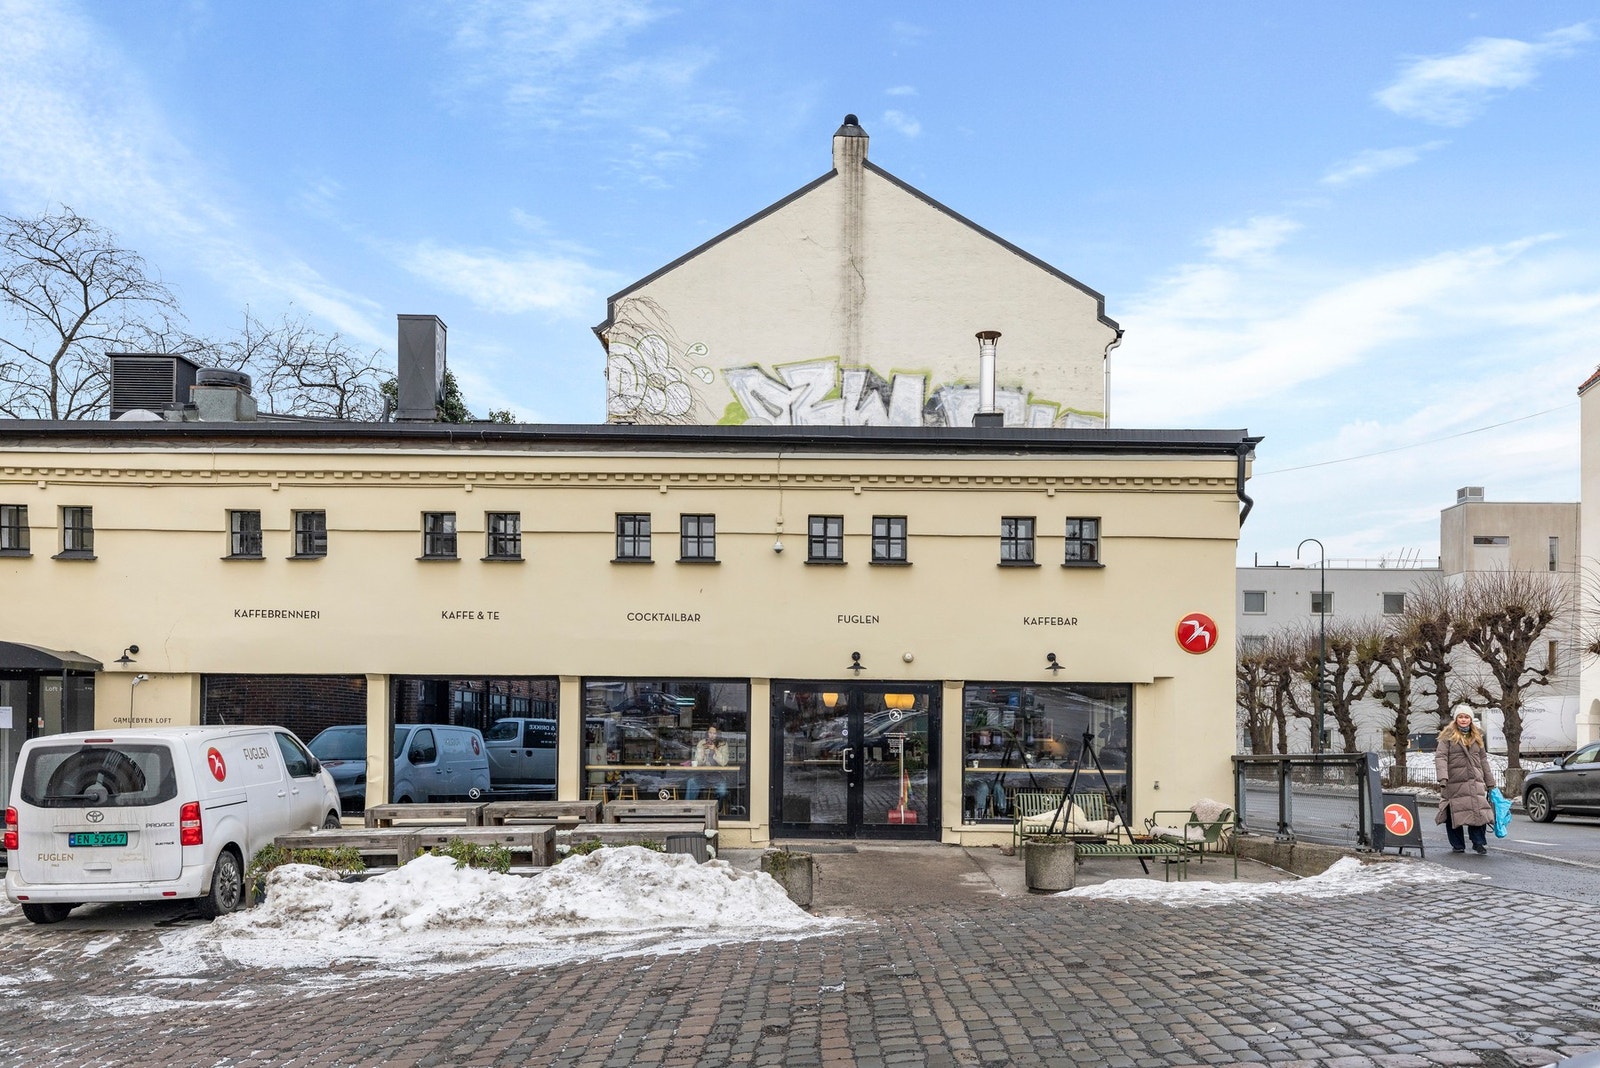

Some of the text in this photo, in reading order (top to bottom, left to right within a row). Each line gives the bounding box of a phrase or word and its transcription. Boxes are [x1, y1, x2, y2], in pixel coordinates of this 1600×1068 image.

[234, 608, 320, 620] KAFFEBRENNERI
[441, 610, 500, 621] KAFFE & TE
[626, 612, 701, 623] COCKTAILBAR
[837, 614, 880, 625] FUGLEN
[1023, 616, 1078, 626] KAFFEBAR
[113, 716, 153, 724] GAMLEBYEN
[242, 746, 271, 761] FUGLEN
[145, 821, 175, 829] PROACE
[77, 834, 125, 844] EN 52647
[37, 853, 74, 862] FUGLEN
